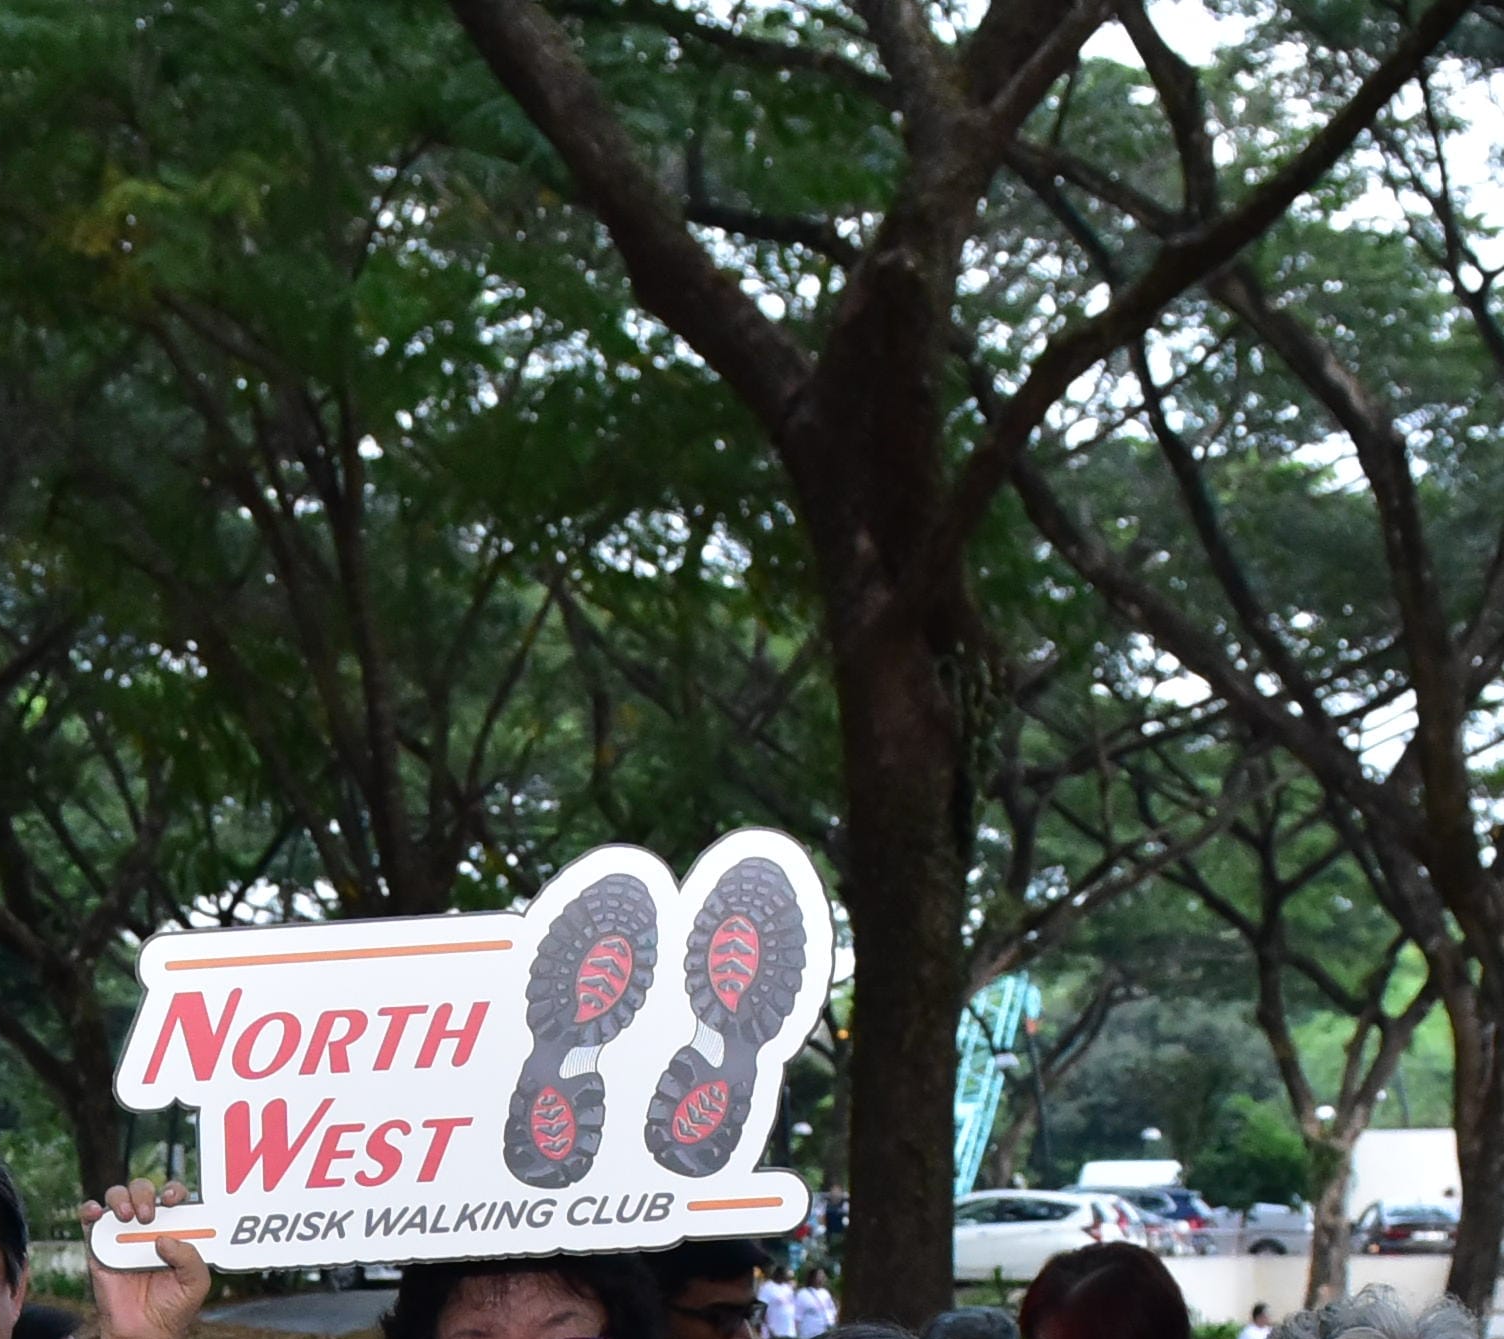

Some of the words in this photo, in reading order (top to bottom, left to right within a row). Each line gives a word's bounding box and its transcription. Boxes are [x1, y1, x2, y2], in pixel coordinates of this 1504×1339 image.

[142, 987, 490, 1084] NORTH
[224, 1097, 472, 1195] WEST
[229, 1207, 353, 1247] BRISK
[364, 1198, 556, 1237] WALKING
[566, 1191, 675, 1225] CLUB
